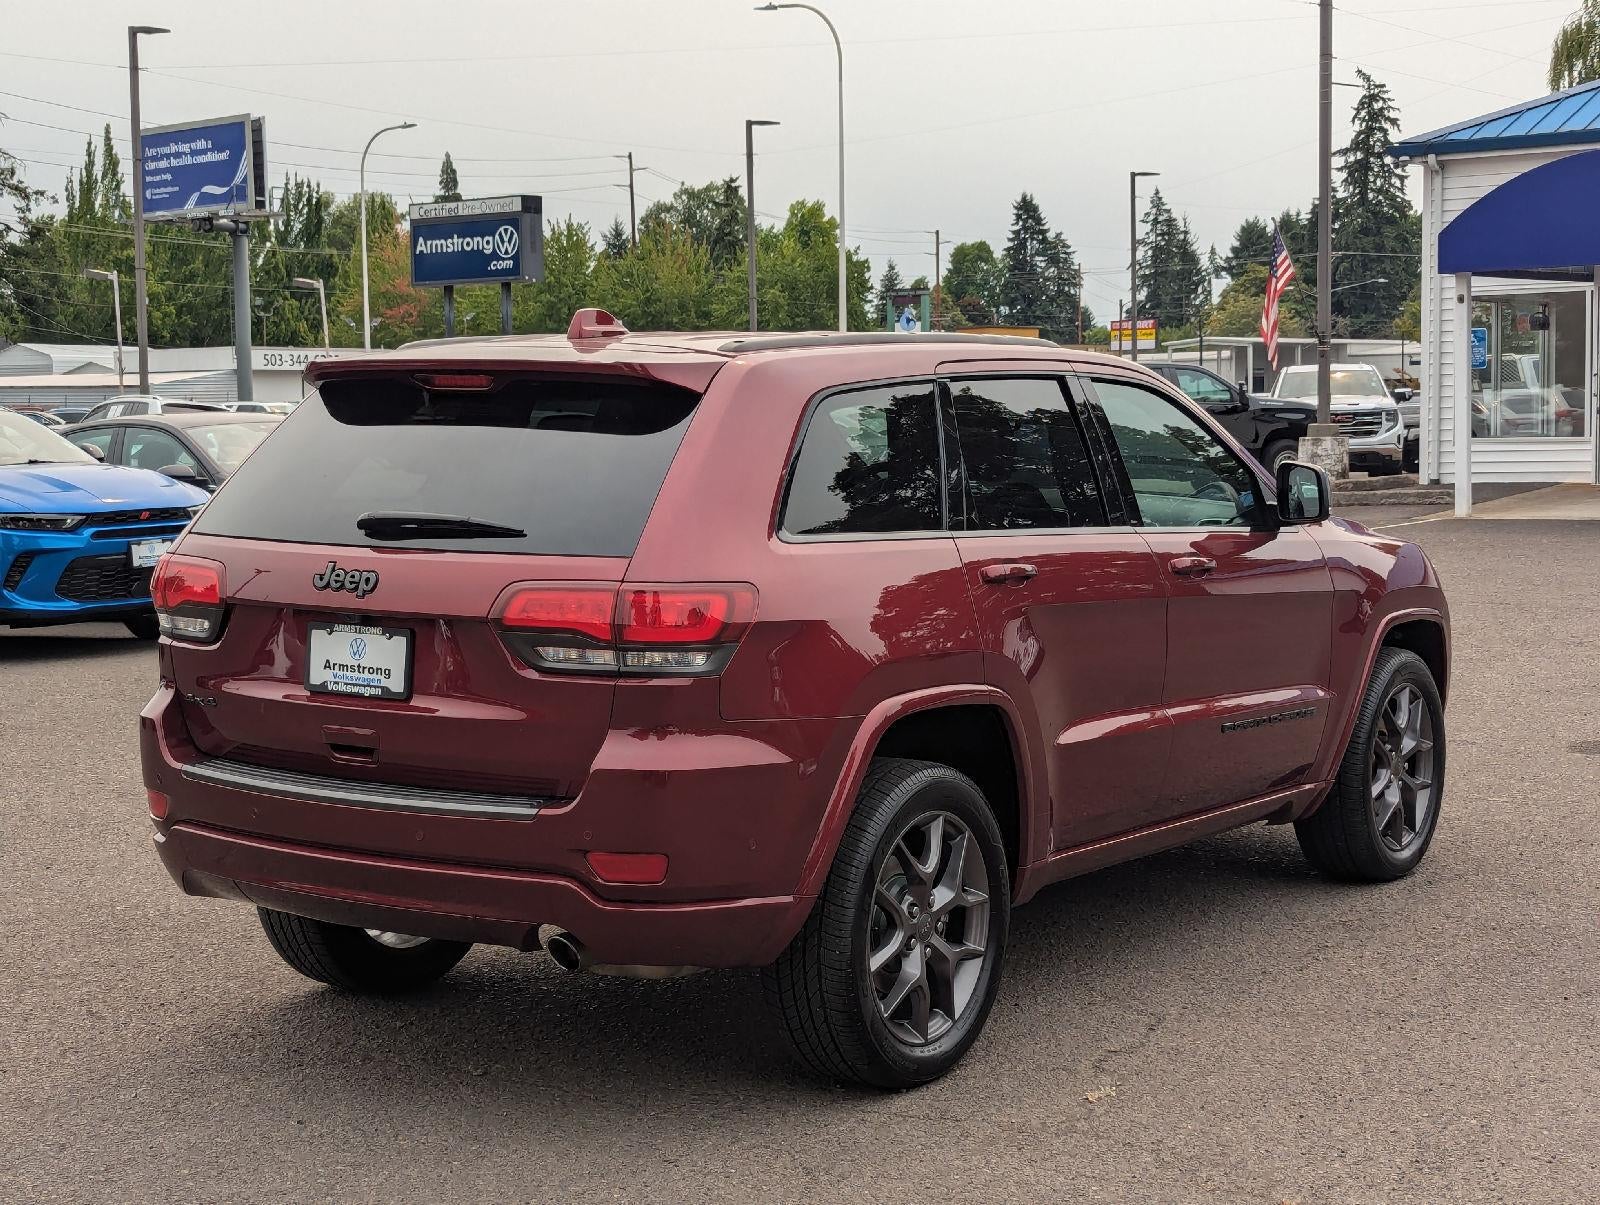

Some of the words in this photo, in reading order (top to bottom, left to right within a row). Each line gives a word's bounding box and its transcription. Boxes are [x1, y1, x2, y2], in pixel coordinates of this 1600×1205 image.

[145, 146, 158, 157] Are
[158, 145, 170, 157] you
[170, 141, 191, 153] living
[191, 138, 207, 150] with
[207, 140, 212, 149] a
[145, 158, 170, 170] chronic
[170, 154, 192, 167] health
[193, 150, 230, 164] condition?
[418, 204, 459, 217] Certified
[462, 199, 514, 214] Pre-Owned
[415, 234, 494, 255] Armstrong
[487, 259, 514, 271] .com
[313, 561, 379, 599] Jeep
[333, 624, 383, 635] ARMSTRONG
[323, 659, 392, 680] Armstrong
[332, 672, 382, 685] Volkswagen
[327, 681, 382, 696] Volkswagen
